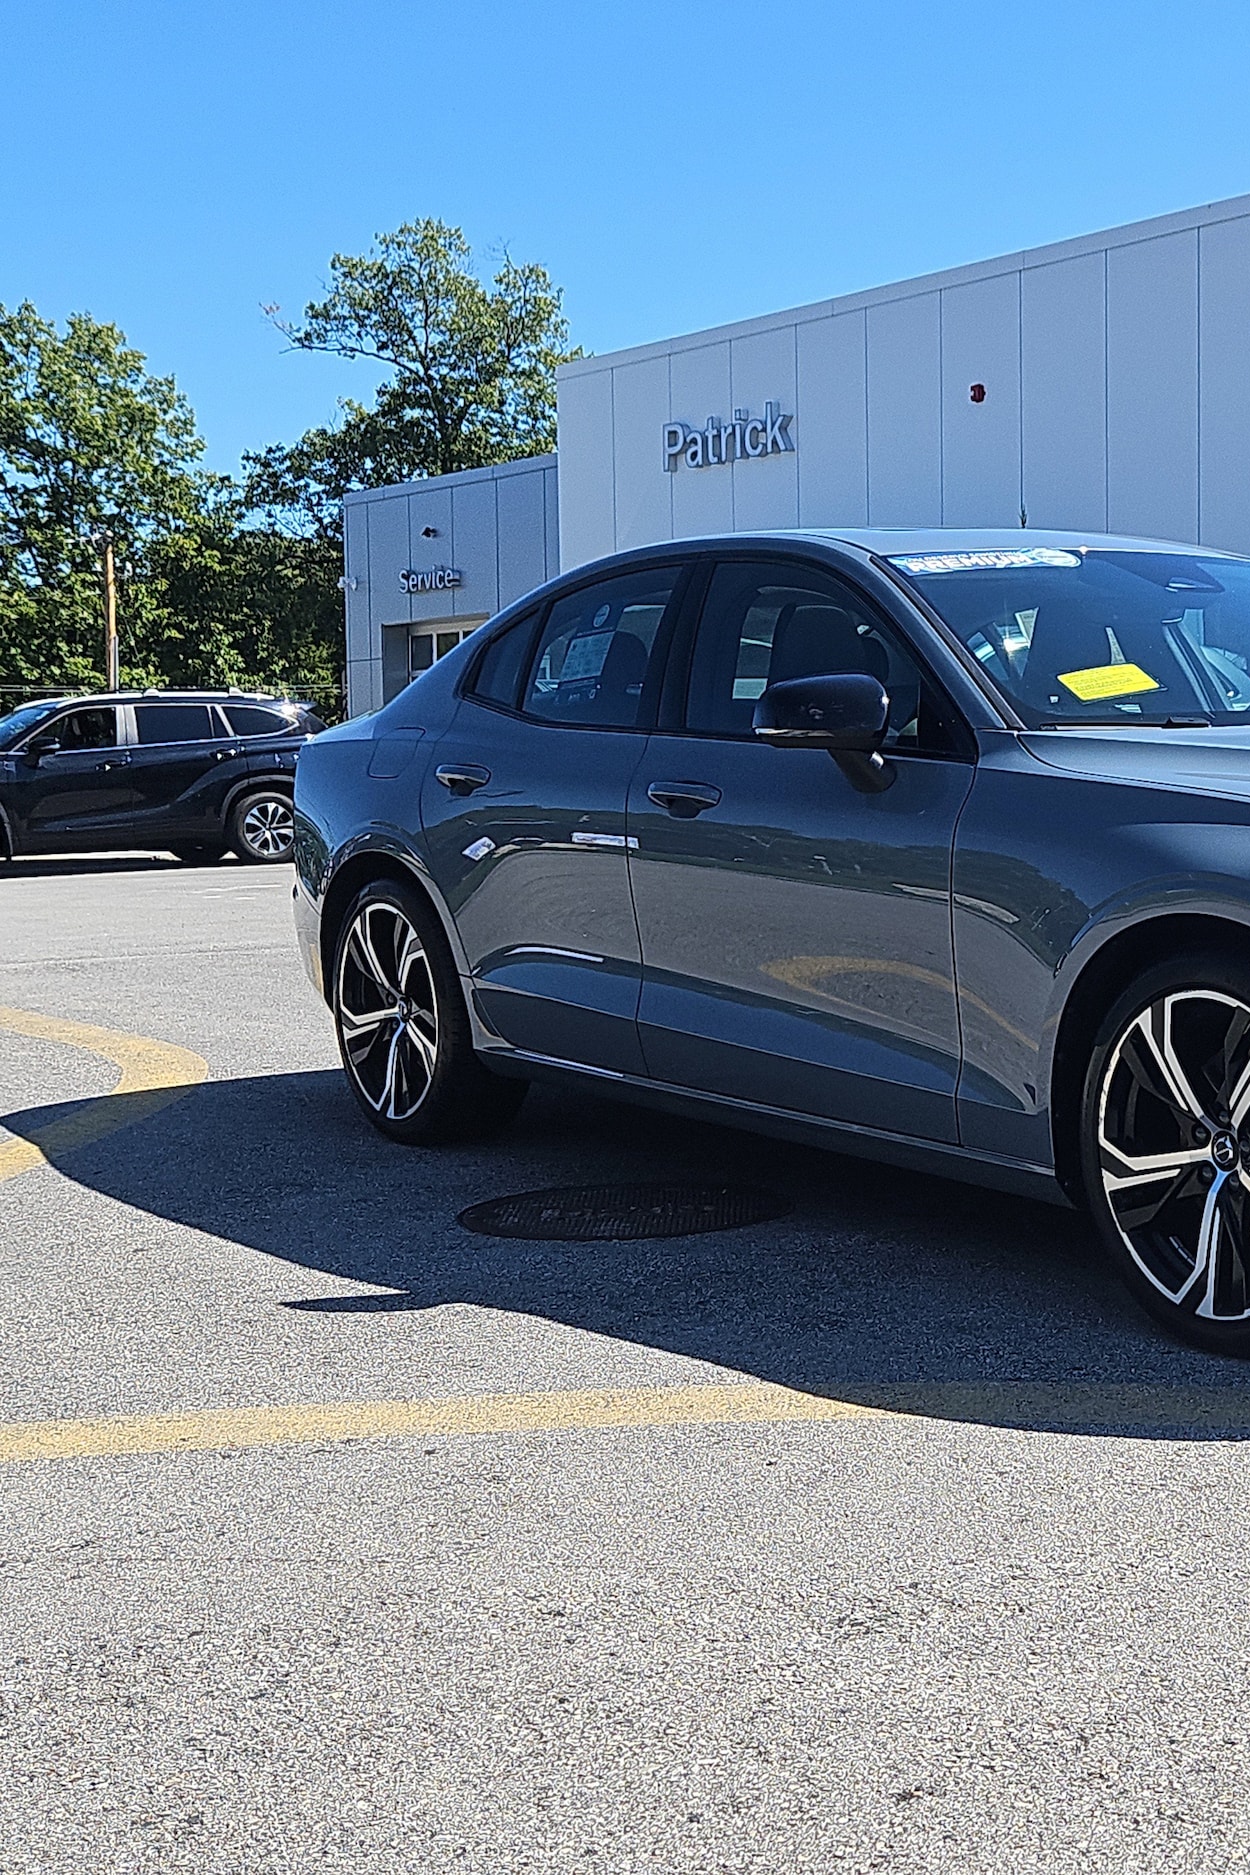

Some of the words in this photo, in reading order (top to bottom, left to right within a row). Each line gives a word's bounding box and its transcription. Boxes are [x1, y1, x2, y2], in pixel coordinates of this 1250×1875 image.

[663, 401, 793, 472] Patrick
[906, 555, 1031, 572] PREMIUM
[399, 564, 457, 593] Service
